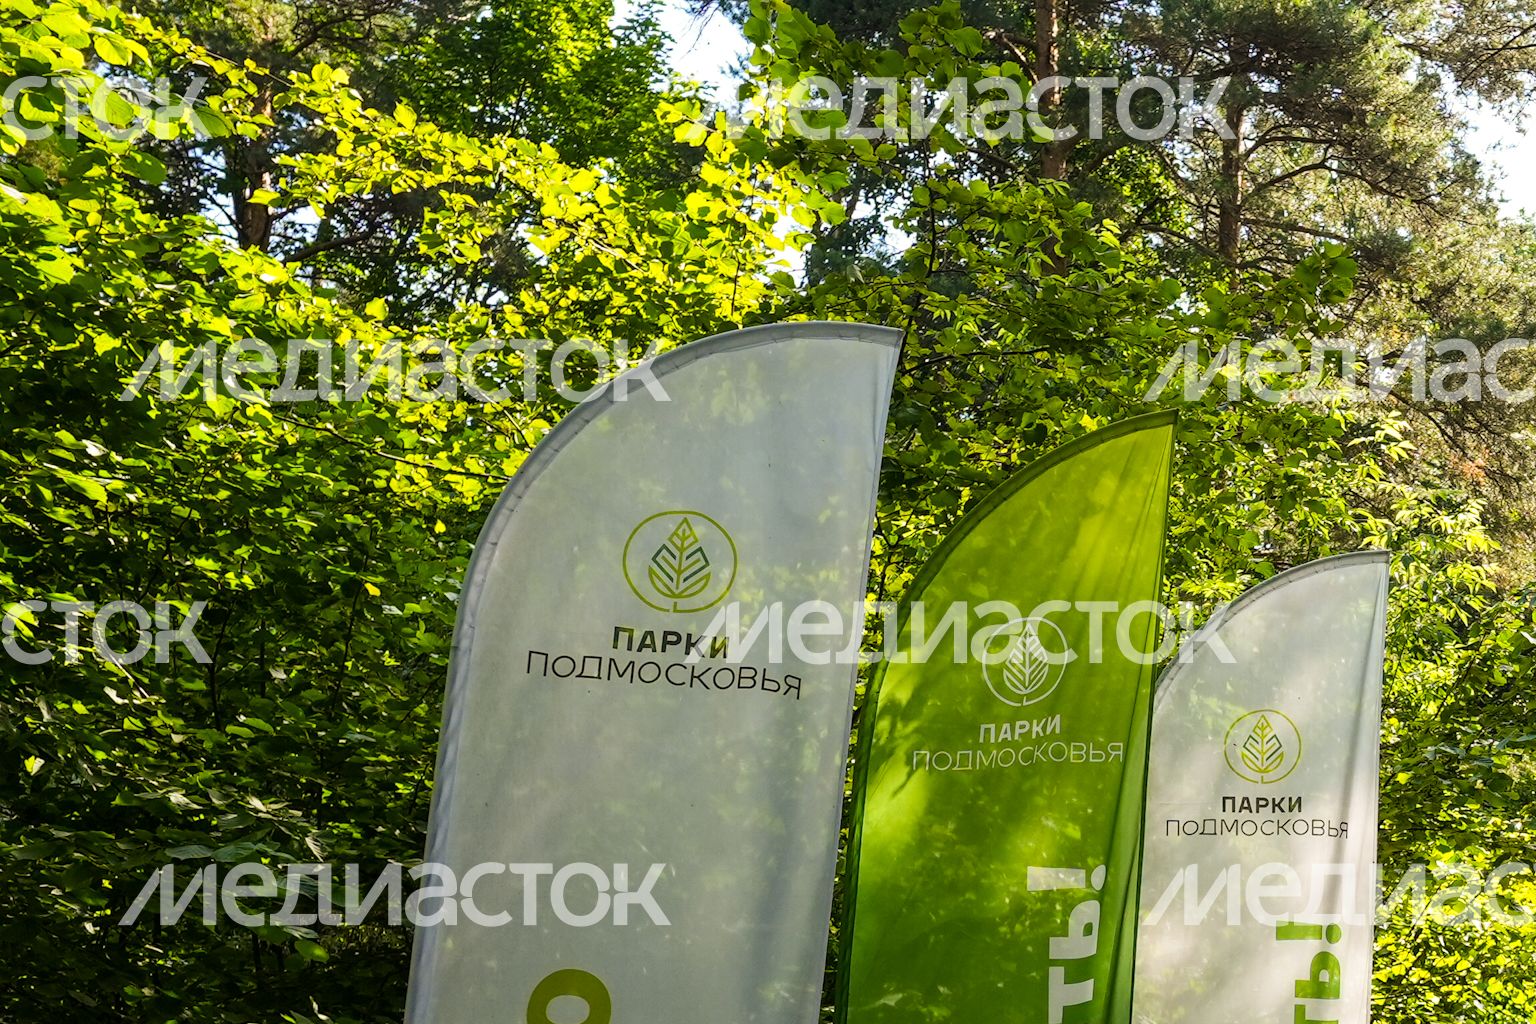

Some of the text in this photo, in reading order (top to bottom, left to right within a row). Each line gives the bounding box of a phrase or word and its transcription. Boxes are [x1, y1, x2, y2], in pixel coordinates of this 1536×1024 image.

[612, 626, 730, 659] ПАРКИ
[526, 650, 802, 700] ПОДМОСКОВЬЯ
[979, 714, 1061, 743] ПАРКИ
[912, 741, 1123, 771] ПОДМОСКОВЬЯ
[1222, 796, 1302, 813] ПАРКИ
[1165, 818, 1348, 839] ПОДМОСКОВЬЯ
